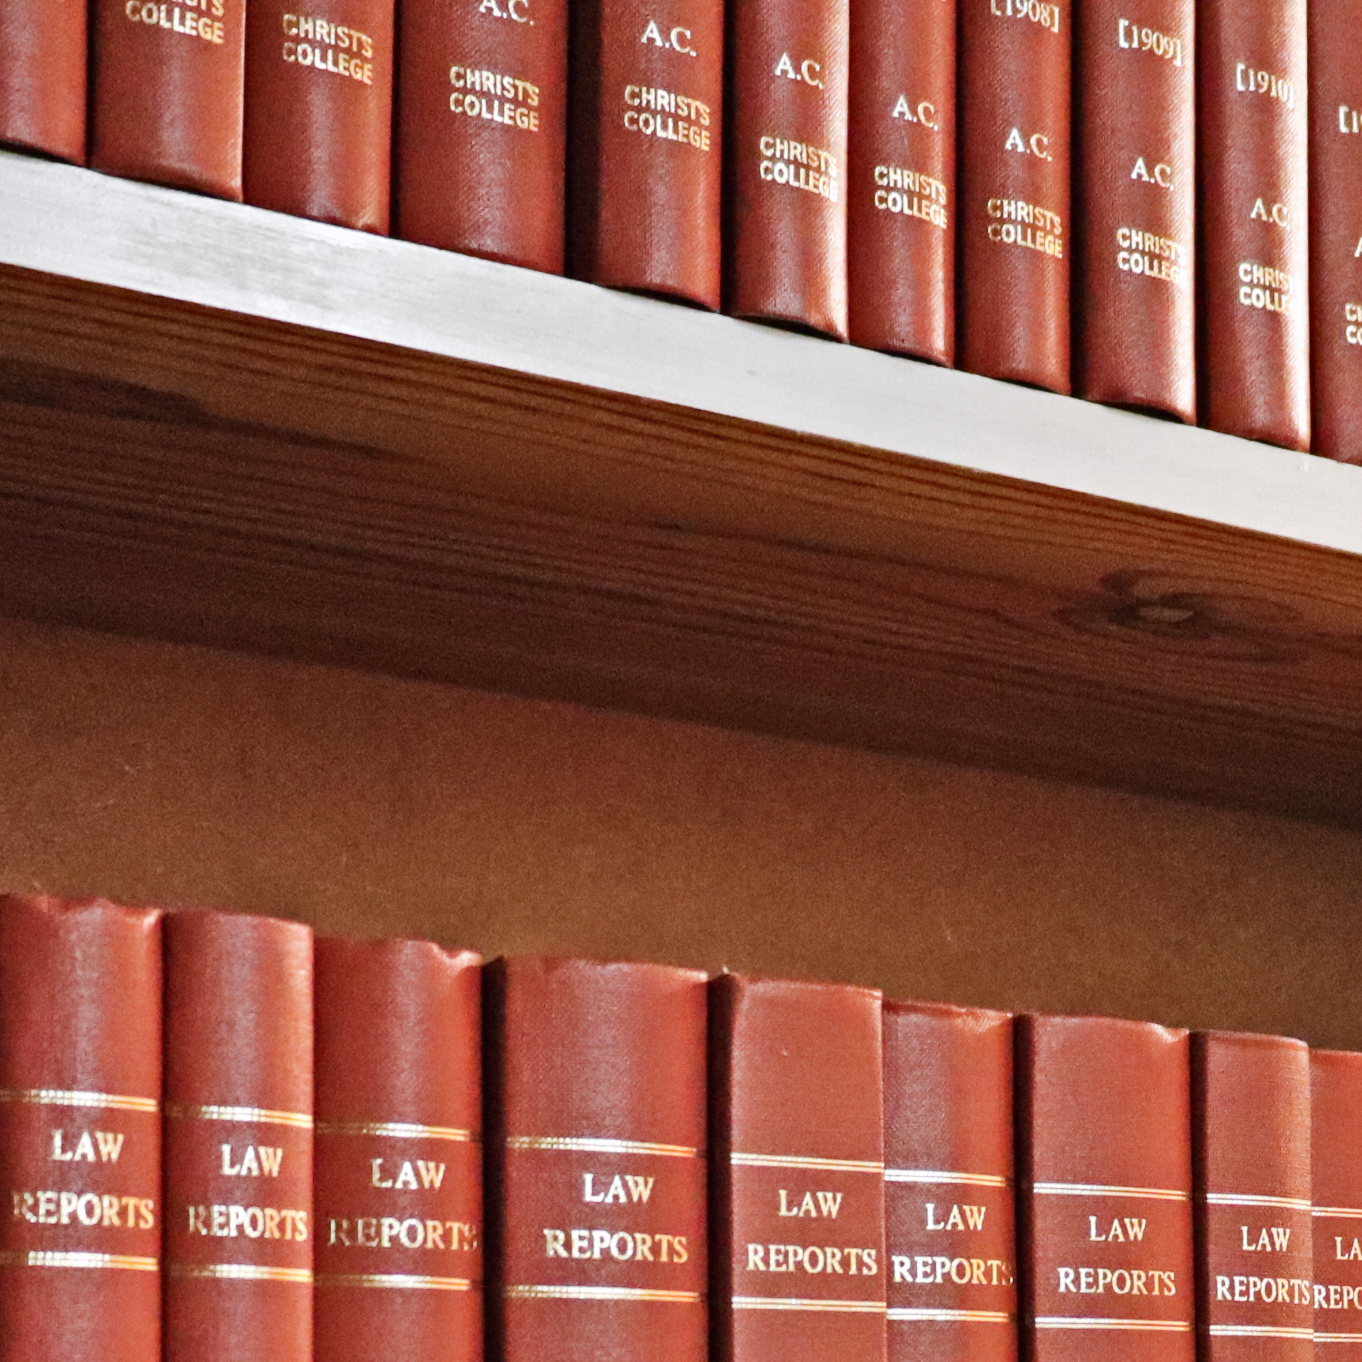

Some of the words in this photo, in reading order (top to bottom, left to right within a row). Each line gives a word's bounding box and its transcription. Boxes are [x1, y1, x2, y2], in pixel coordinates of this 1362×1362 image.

[125, 0, 225, 44] COLLEGE
[640, 20, 697, 57] A.C.
[1118, 18, 1183, 67] [1909]
[282, 41, 374, 86] COLLEGE
[774, 52, 824, 90] A.C.
[1236, 62, 1295, 109] [1910]
[449, 91, 540, 132] COLLEGE
[891, 94, 939, 131] A.C.
[624, 111, 711, 151] COLLEGE
[1004, 127, 1053, 161] A.C.
[759, 160, 839, 202] COLLEGE
[1131, 156, 1175, 191] A.C.
[874, 190, 948, 229] COLLEGE
[987, 223, 1063, 258] COLLEGE
[51, 1128, 124, 1163] LAW
[220, 1144, 283, 1177] LAW
[372, 1158, 446, 1190] LAW
[583, 1173, 655, 1204] LAW
[778, 1189, 842, 1219] LAW
[925, 1203, 987, 1232] LAW
[188, 1204, 309, 1241] REPORTS
[1088, 1215, 1147, 1243] LAW
[1241, 1225, 1291, 1253] LAW
[543, 1228, 689, 1264] REPORTS
[746, 1242, 878, 1276] REPORTS
[892, 1254, 1015, 1287] REPORTS
[1057, 1266, 1177, 1297] REPORTS
[1215, 1275, 1310, 1306] REPORTS
